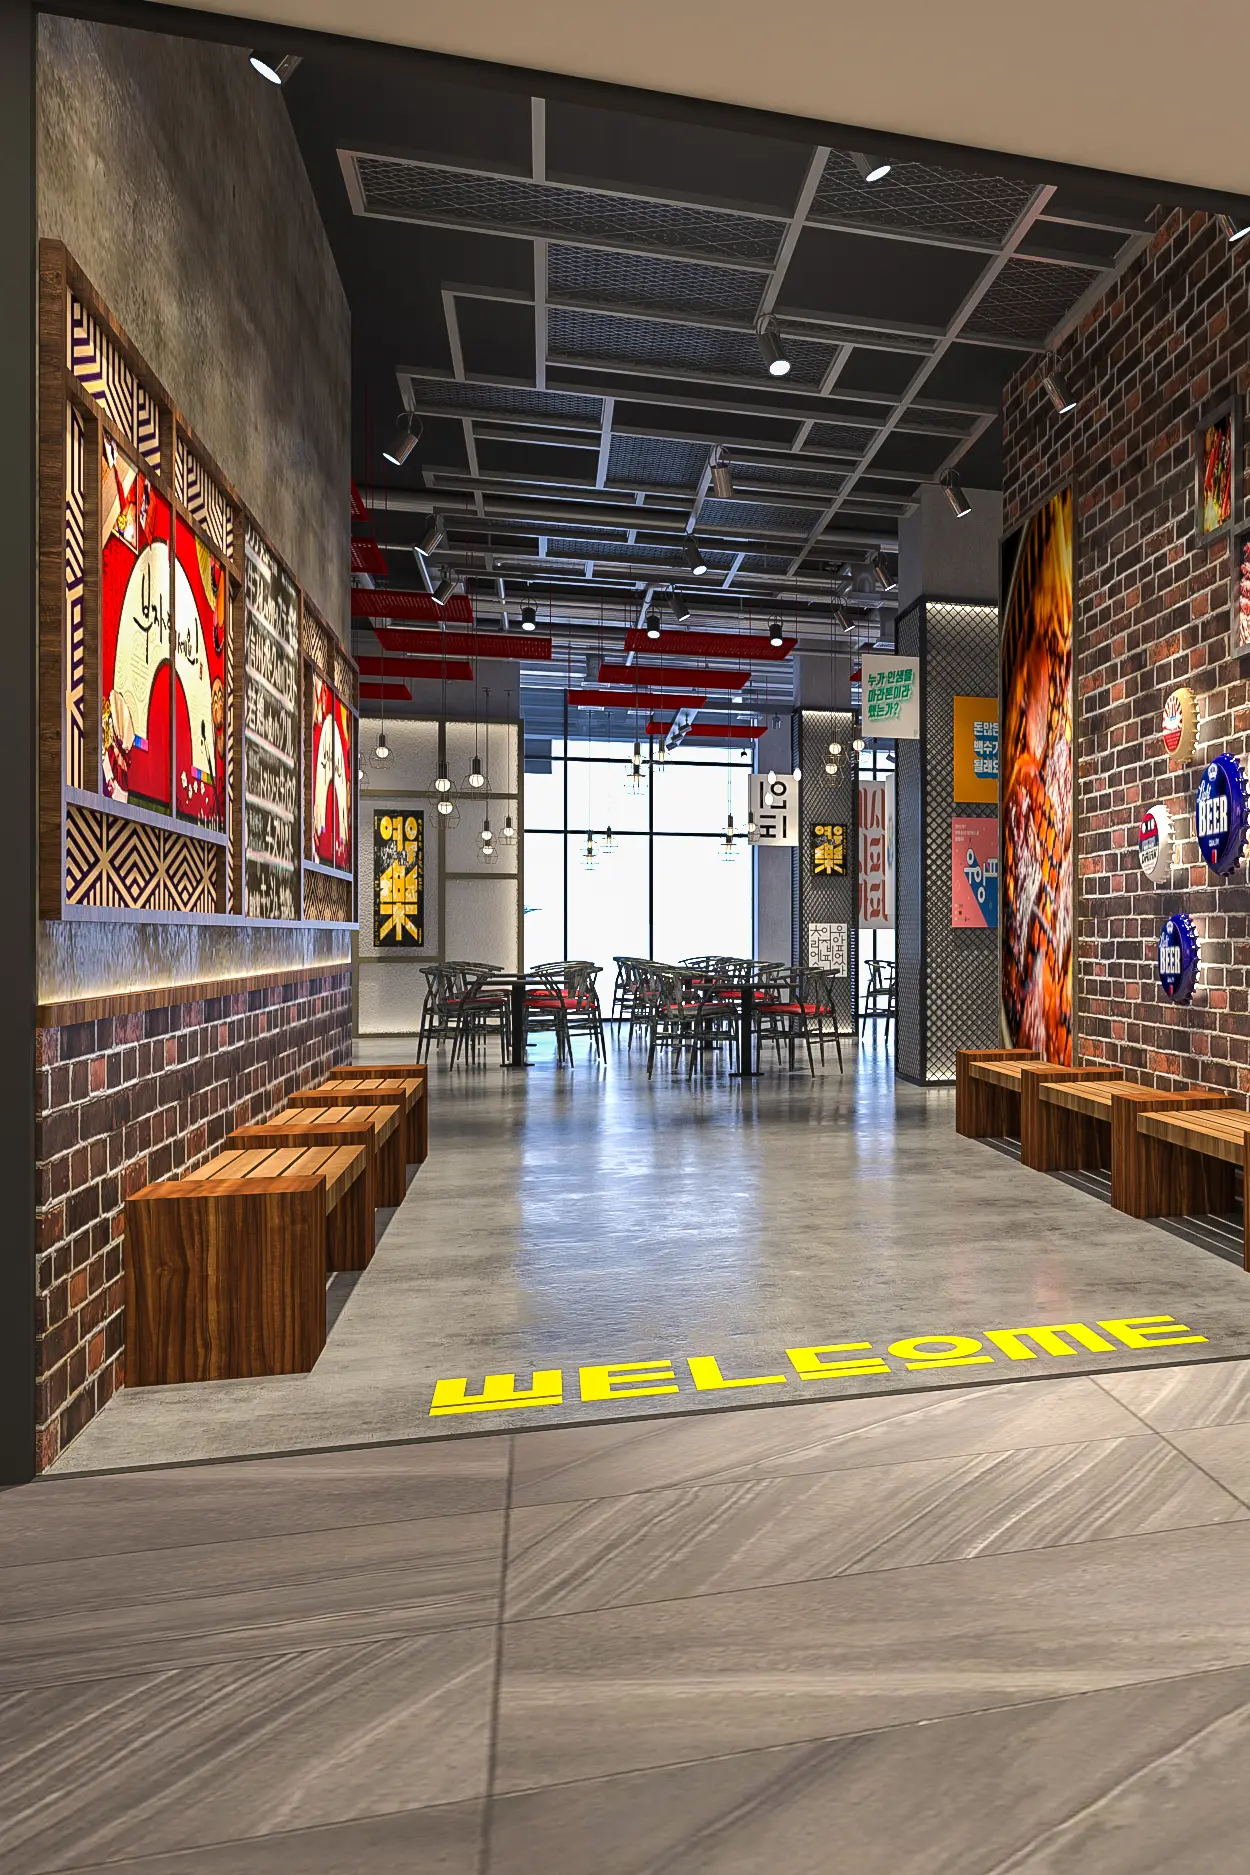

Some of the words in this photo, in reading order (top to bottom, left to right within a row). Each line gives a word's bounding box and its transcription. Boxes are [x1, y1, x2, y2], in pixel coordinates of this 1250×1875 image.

[868, 672, 885, 687] 누가
[1198, 794, 1228, 838] BEER
[1160, 945, 1181, 975] BEER
[429, 1315, 1208, 1416] WELCOME
